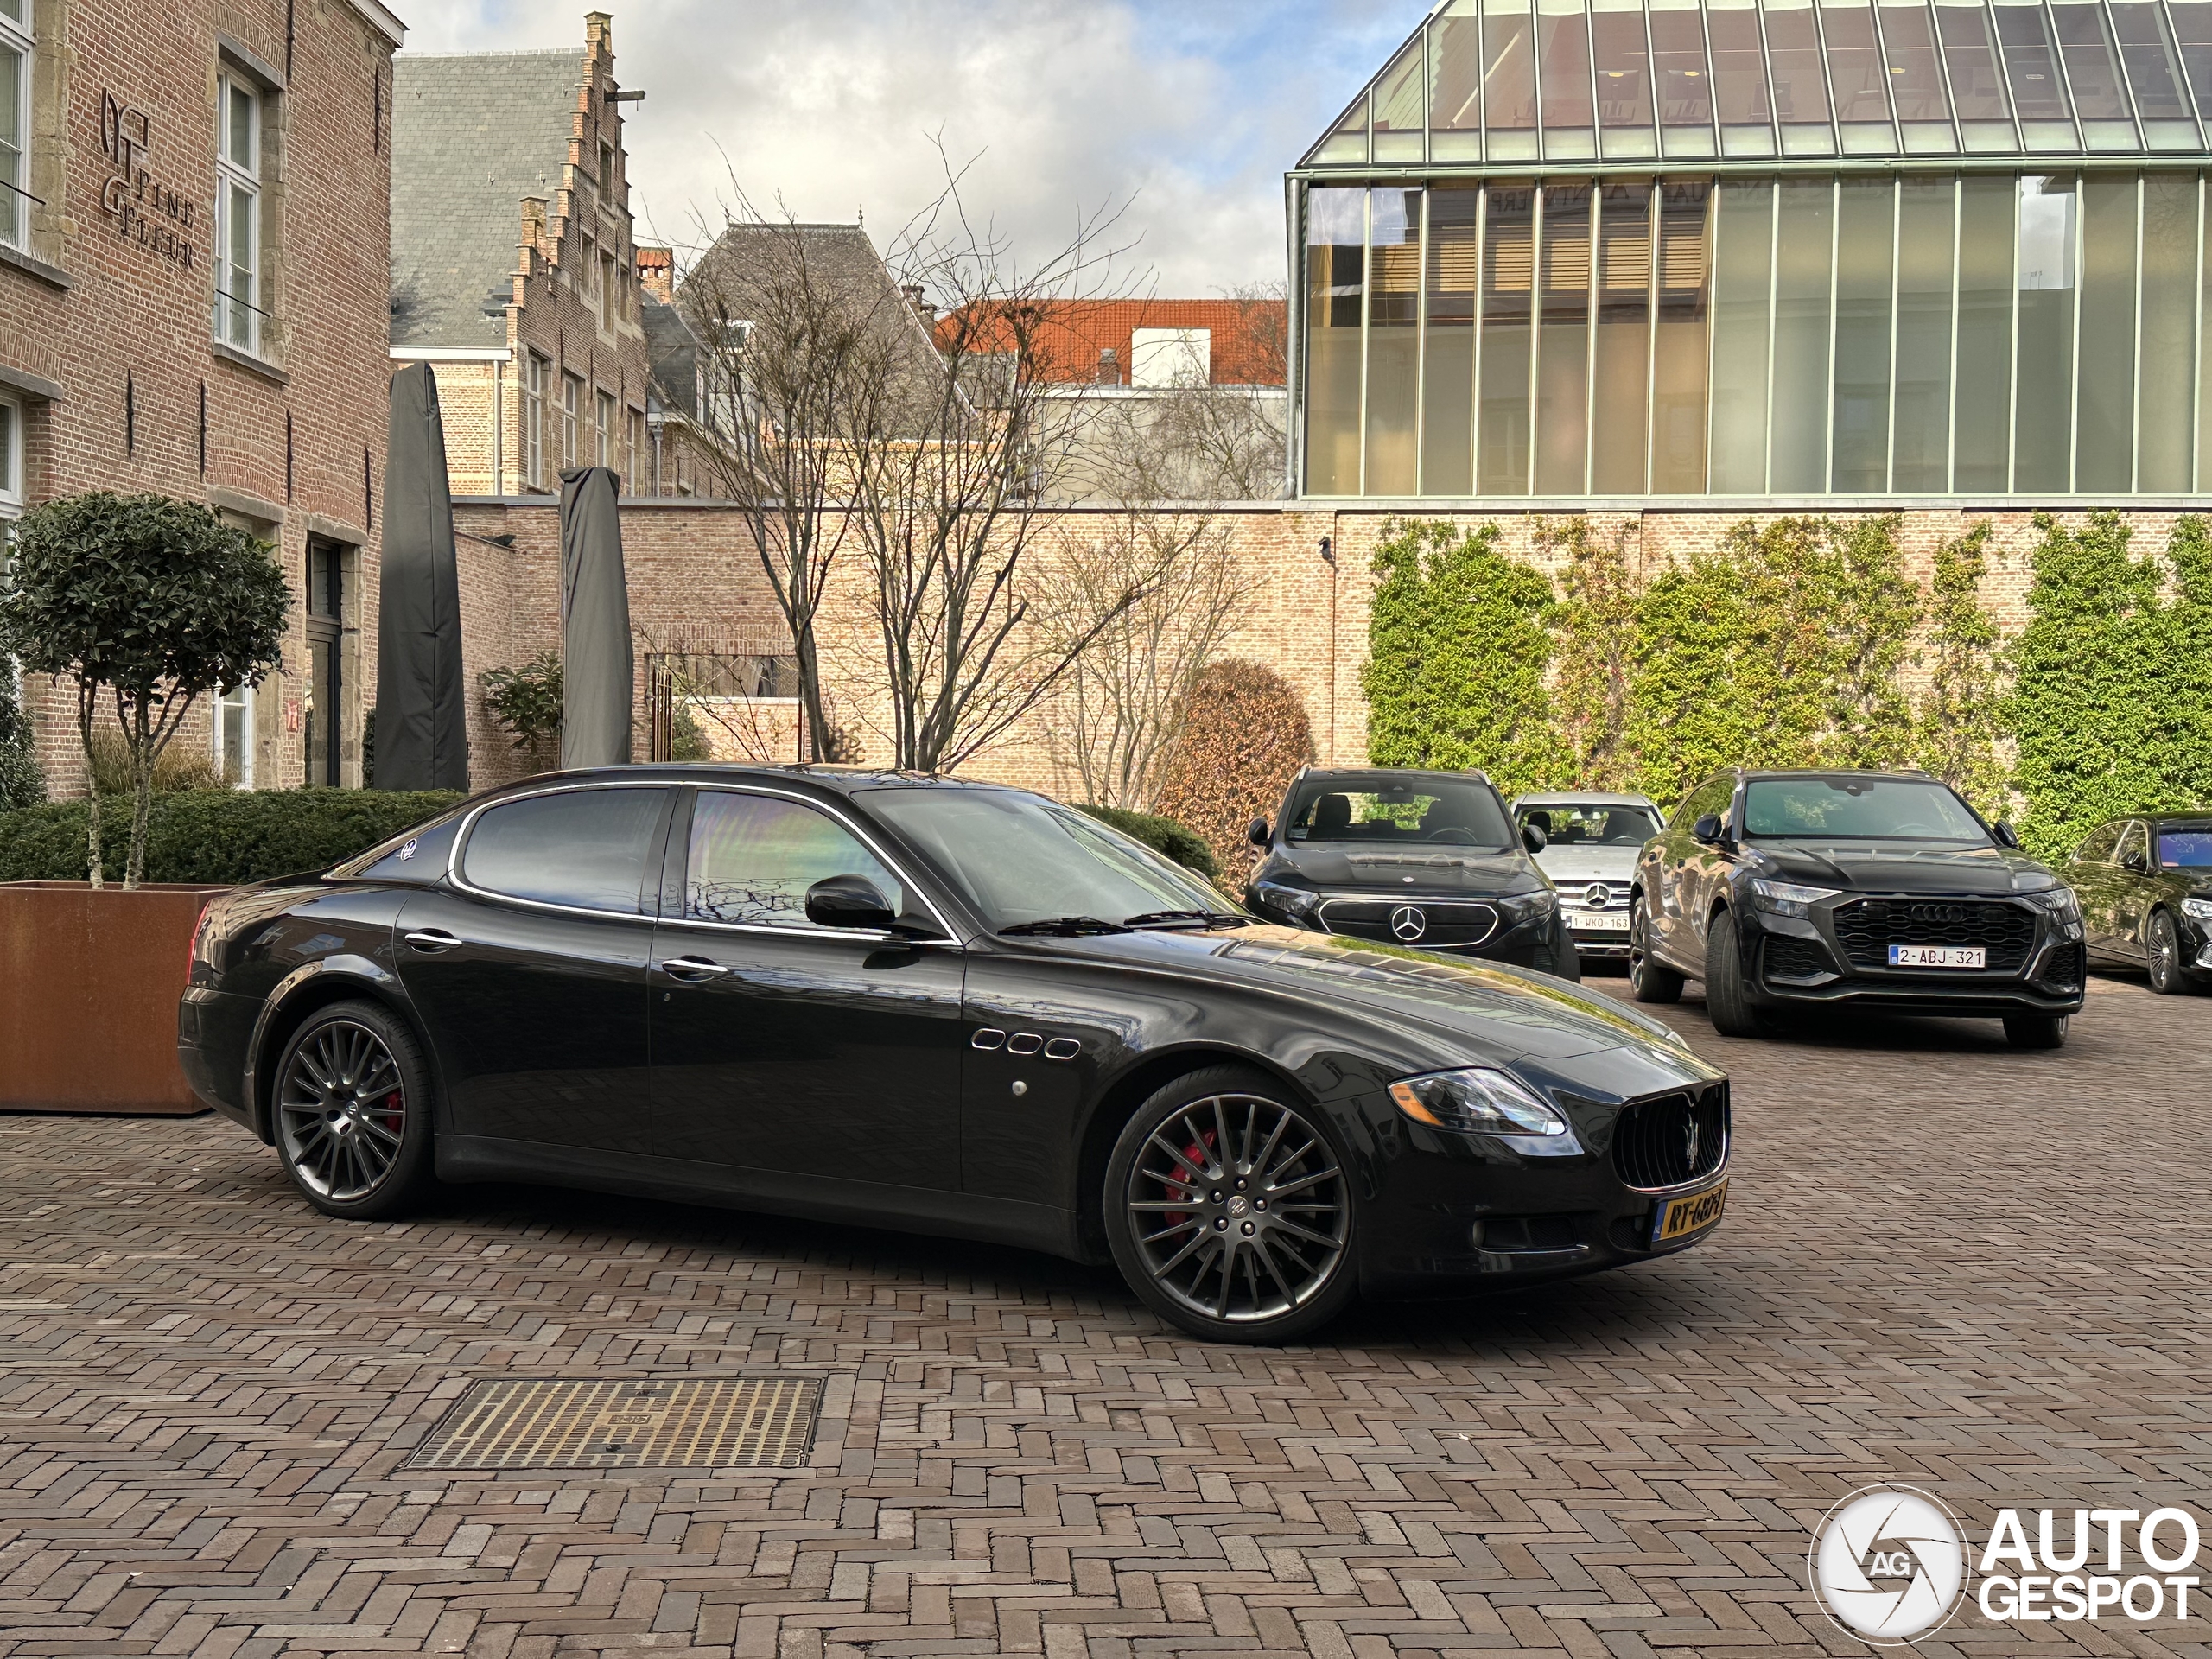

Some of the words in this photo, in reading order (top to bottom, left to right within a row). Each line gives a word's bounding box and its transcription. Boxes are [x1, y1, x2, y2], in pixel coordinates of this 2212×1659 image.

[137, 168, 194, 230] FINE
[120, 202, 194, 270] FLEUR
[1900, 949, 1981, 965] 2-ABJ-321
